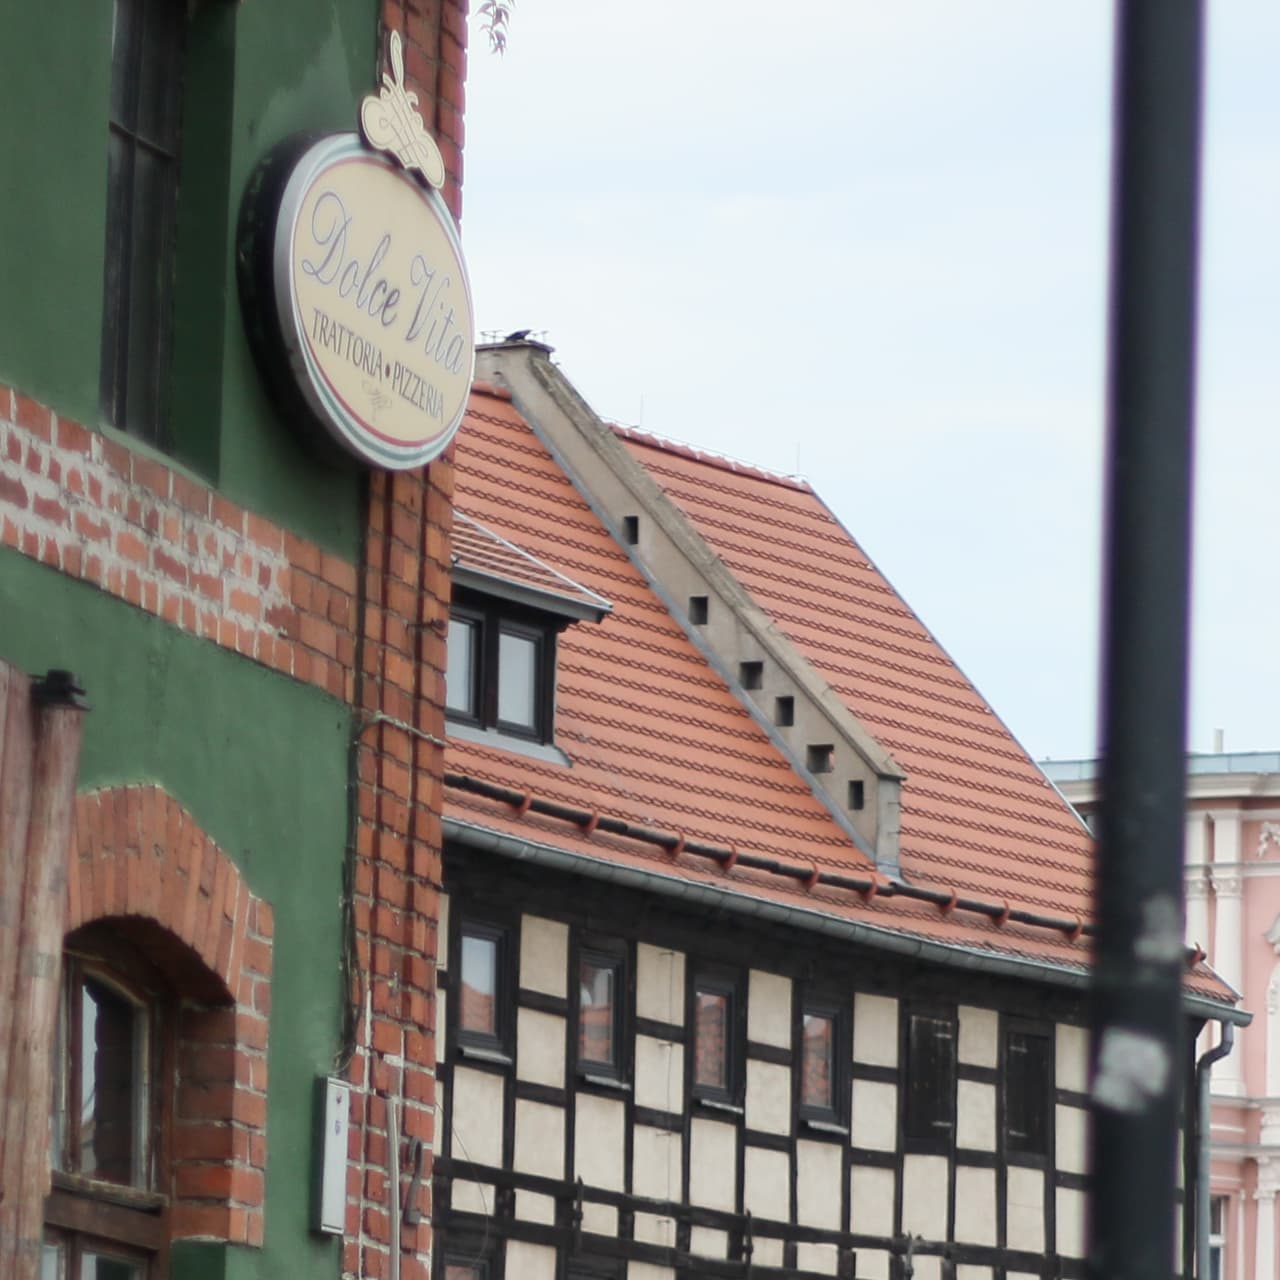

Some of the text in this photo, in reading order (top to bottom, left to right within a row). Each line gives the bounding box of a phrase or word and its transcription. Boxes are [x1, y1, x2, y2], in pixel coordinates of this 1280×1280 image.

[301, 191, 466, 376] Dolce Vita
[312, 307, 445, 425] TRATTORIA PIZZERIA
